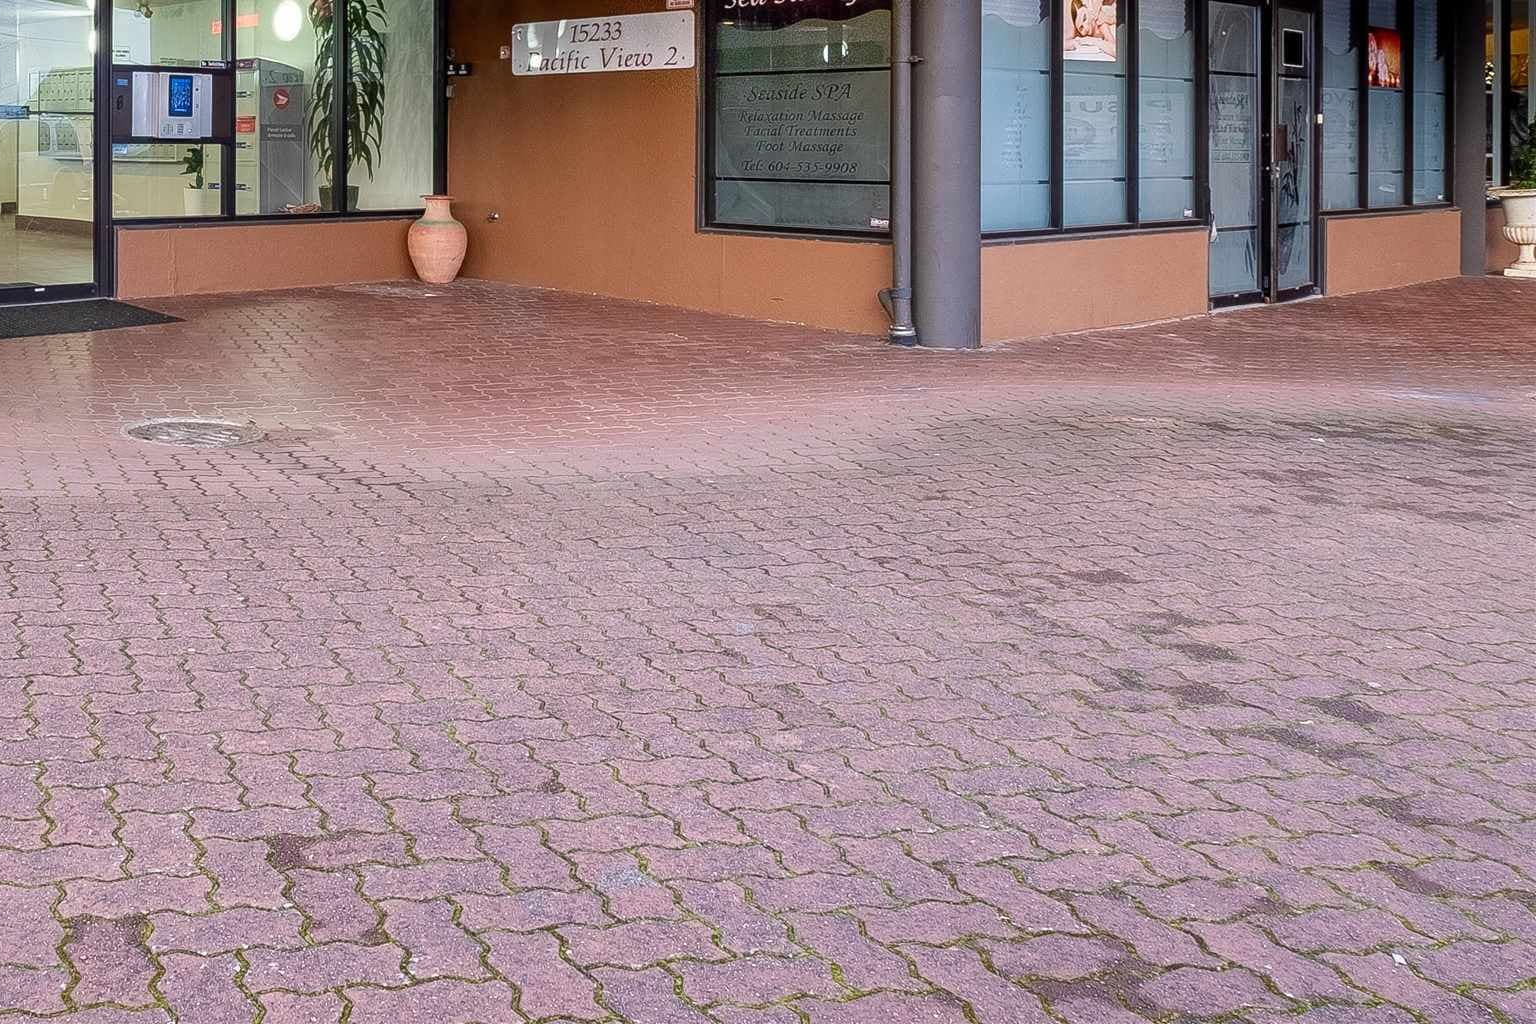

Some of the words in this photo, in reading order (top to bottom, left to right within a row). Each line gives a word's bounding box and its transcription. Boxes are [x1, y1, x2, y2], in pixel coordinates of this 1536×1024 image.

[569, 21, 622, 43] 15233
[599, 47, 654, 69] View
[664, 46, 678, 66] 2
[747, 83, 808, 102] Seaside
[811, 83, 852, 101] SPA
[738, 110, 804, 123] Relaxation
[808, 110, 865, 124] Massage
[744, 125, 782, 137] Facial
[785, 125, 858, 137] Treatments
[756, 140, 784, 152] Foot
[788, 140, 844, 155] Massage
[743, 159, 764, 172] Tel:
[767, 160, 858, 173] 604-535-9908
